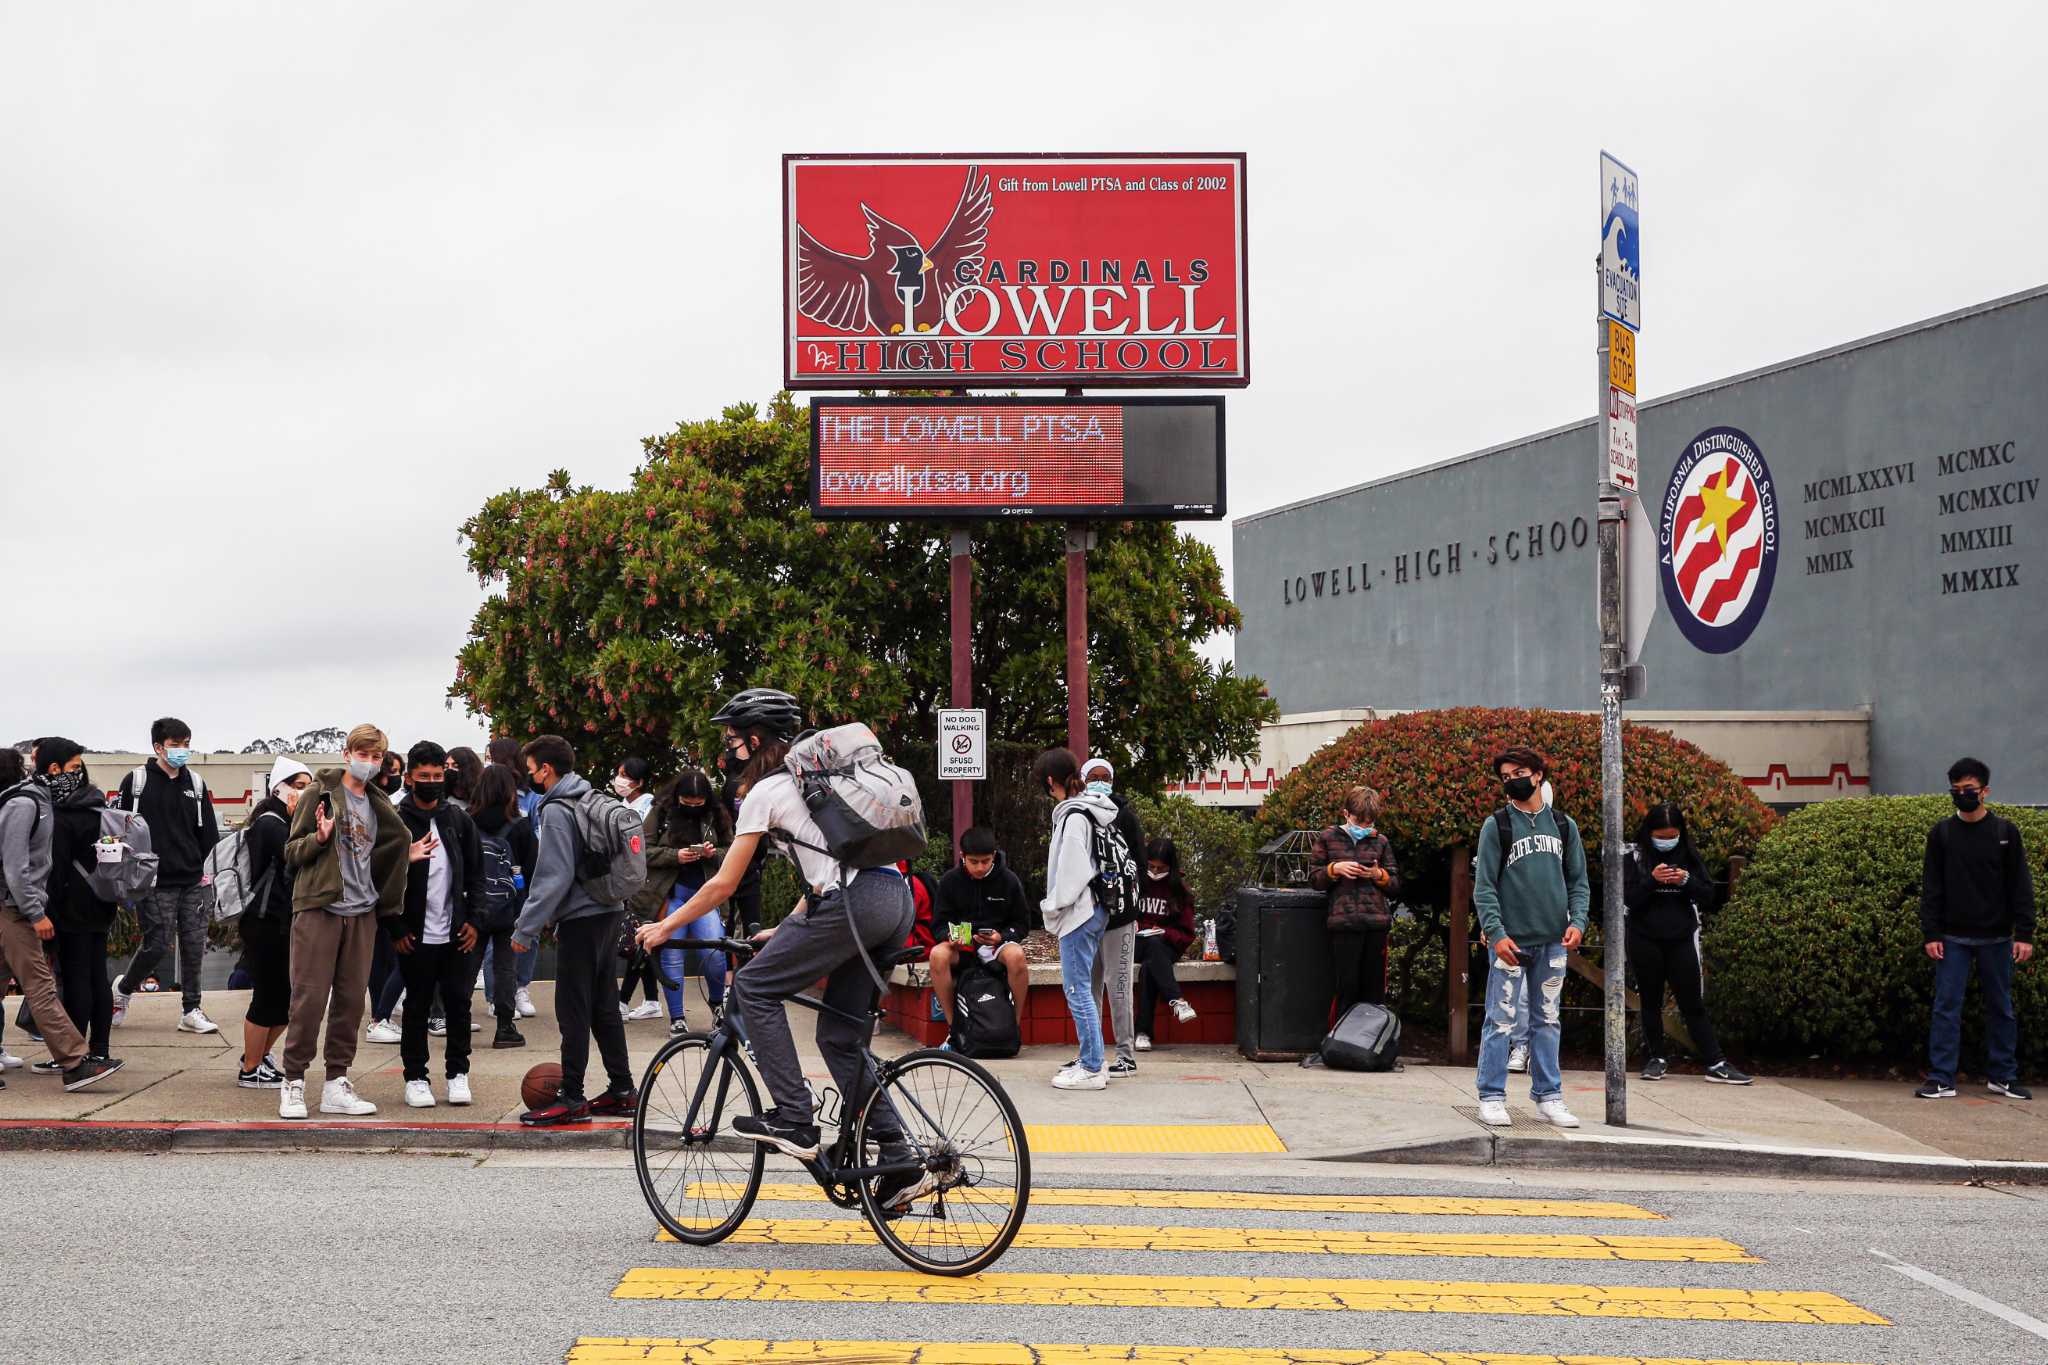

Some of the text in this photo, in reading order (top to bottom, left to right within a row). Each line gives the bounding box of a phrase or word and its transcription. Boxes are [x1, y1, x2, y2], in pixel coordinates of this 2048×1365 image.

[998, 176, 1226, 191] Gift from Lowell PTSA and Class of 2002
[955, 259, 1211, 283] CARDINALS
[898, 284, 1226, 336] LOWELL
[1616, 295, 1628, 317] SITE
[835, 341, 974, 372] HIGH
[1001, 340, 1229, 371] SCHOOL
[1615, 329, 1631, 359] BUS
[1613, 356, 1633, 385] STOP
[820, 415, 1105, 443] THE LOWELL PTSA
[1936, 440, 2016, 476] MCMXC
[820, 464, 1030, 497] lowellptsa.org
[1803, 462, 1915, 503] MCMLXXXVI
[1661, 455, 1694, 546] CALIFORNIA
[1938, 478, 2041, 516] MCMXCIV
[1760, 481, 1775, 554] SCHOOL
[1804, 506, 1886, 540] MCMXCII
[1939, 524, 2014, 554] MMXIII
[1283, 512, 1600, 605] LOWELL HIGH SCHOO
[1661, 551, 1671, 564] A
[1805, 549, 1855, 576] MMIX
[1941, 564, 2020, 595] MMXIX
[943, 766, 981, 774] PROPERTY
